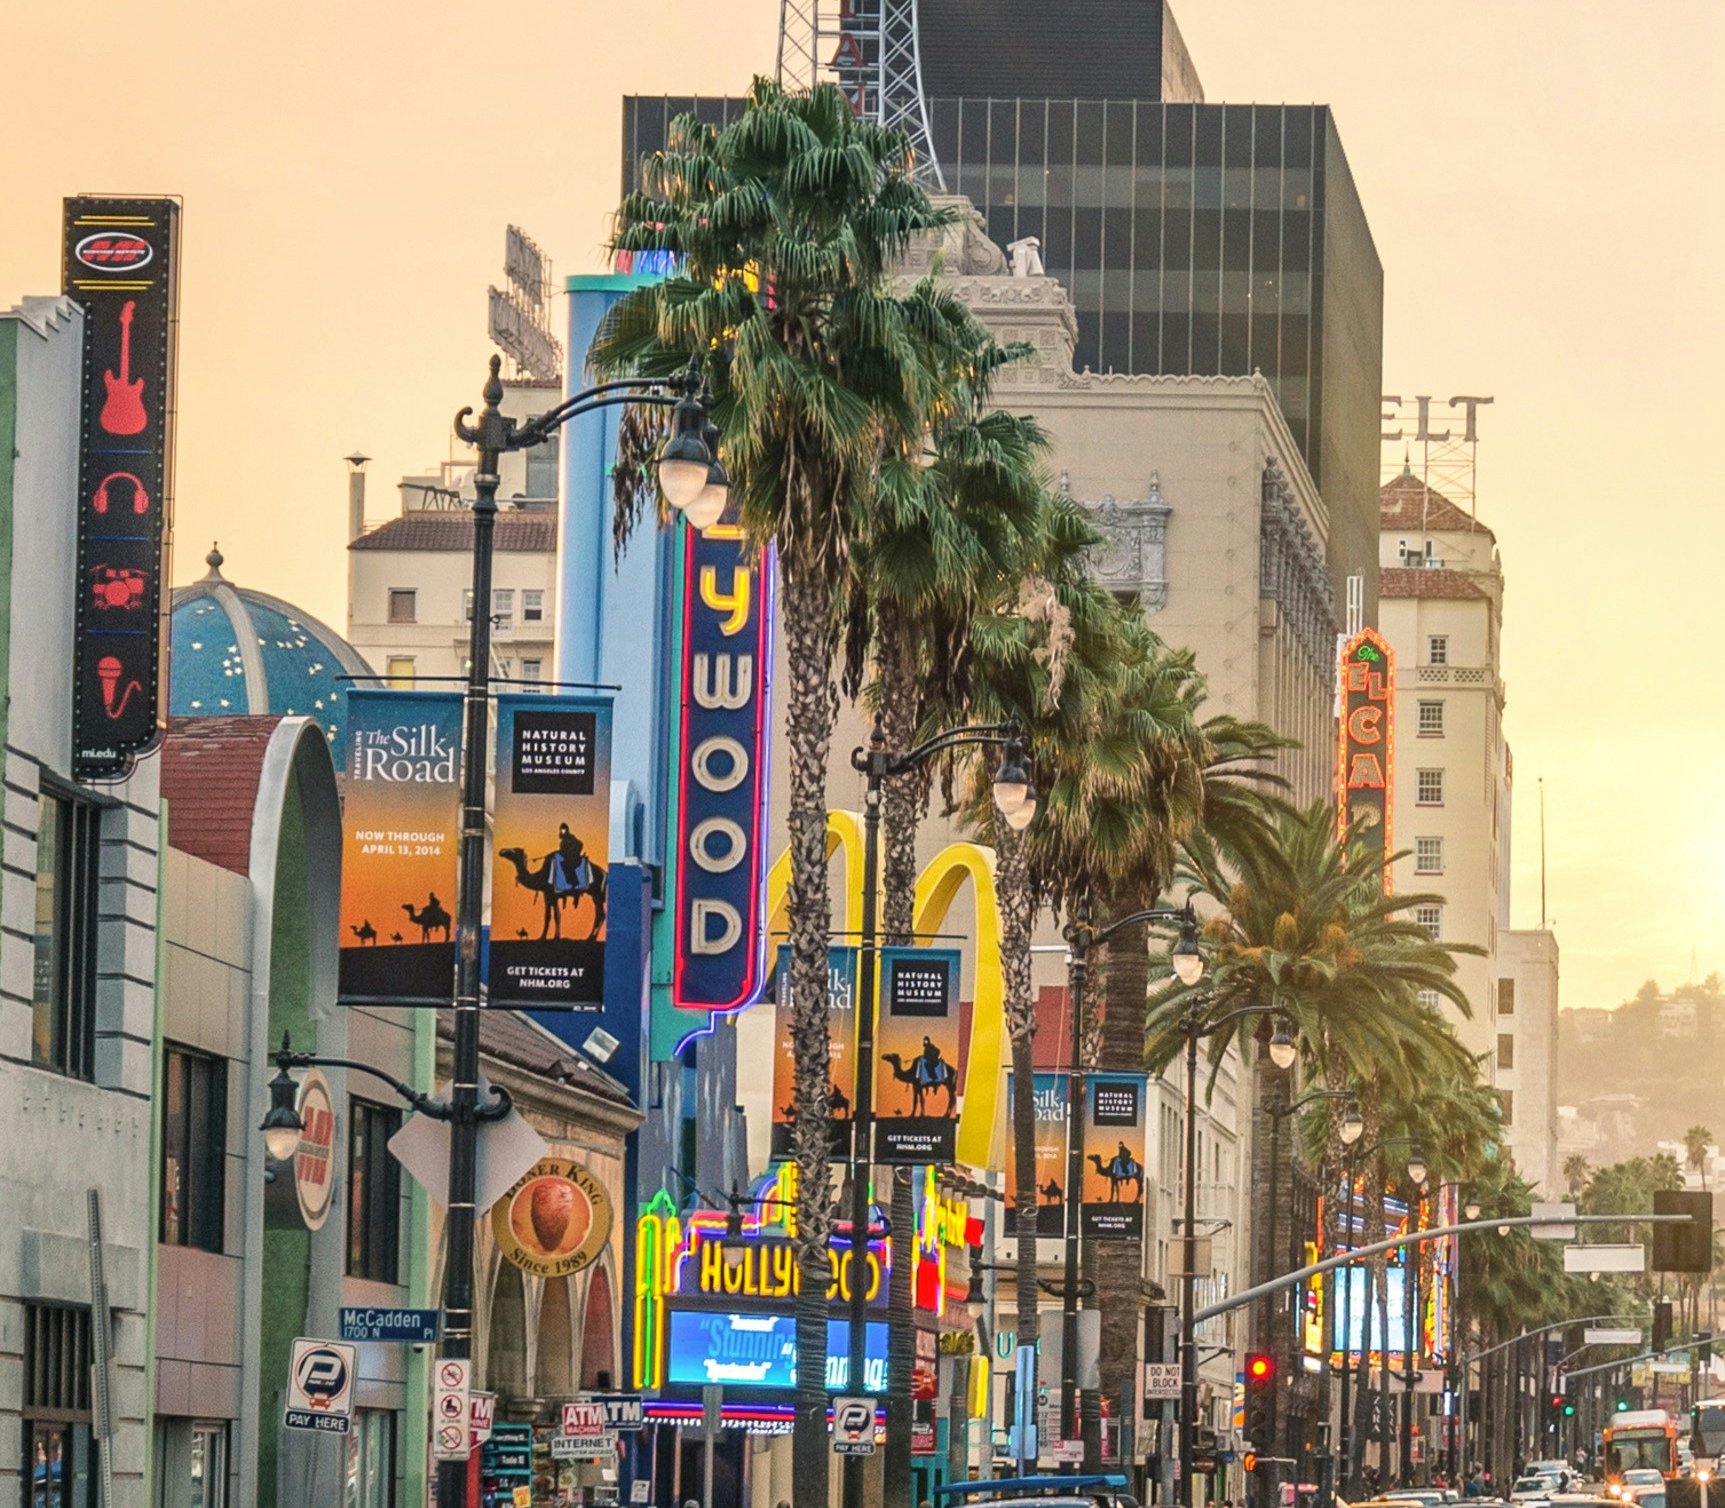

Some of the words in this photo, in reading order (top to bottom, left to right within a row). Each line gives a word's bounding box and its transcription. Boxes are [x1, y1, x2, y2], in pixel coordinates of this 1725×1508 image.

[366, 728, 391, 746] The
[391, 723, 448, 758] Silk
[522, 729, 587, 741] NATURAL
[81, 747, 117, 759] mi.edu
[522, 742, 587, 753] HISTORY
[364, 747, 456, 784] Road
[521, 754, 587, 766] MUSEUM
[355, 830, 386, 842] NOW
[387, 831, 446, 844] THROUGH
[361, 843, 394, 855] APRIL
[396, 845, 412, 857] 13,
[414, 845, 441, 857] 2014
[507, 965, 526, 976] GET
[528, 966, 569, 977] TICKETS
[570, 967, 585, 977] AT
[897, 971, 943, 981] NATURAL
[519, 978, 571, 989] NHM.ORG
[897, 980, 943, 989] HISTORY
[896, 988, 943, 998] MUSEUM
[888, 1134, 902, 1143] GET
[903, 1135, 931, 1143] TICKETS
[510, 1247, 549, 1274] Since
[555, 1250, 588, 1274] 1989
[344, 1310, 421, 1328] McCadden
[343, 1326, 369, 1338] 1700
[372, 1327, 381, 1338] N
[1150, 1367, 1162, 1377] DO
[1165, 1367, 1180, 1378] NOT
[1152, 1377, 1179, 1388] BLOCK
[565, 1405, 603, 1426] ATM
[289, 1413, 310, 1427] PAY
[314, 1415, 346, 1432] HERE
[554, 1437, 612, 1448] INTERNET
